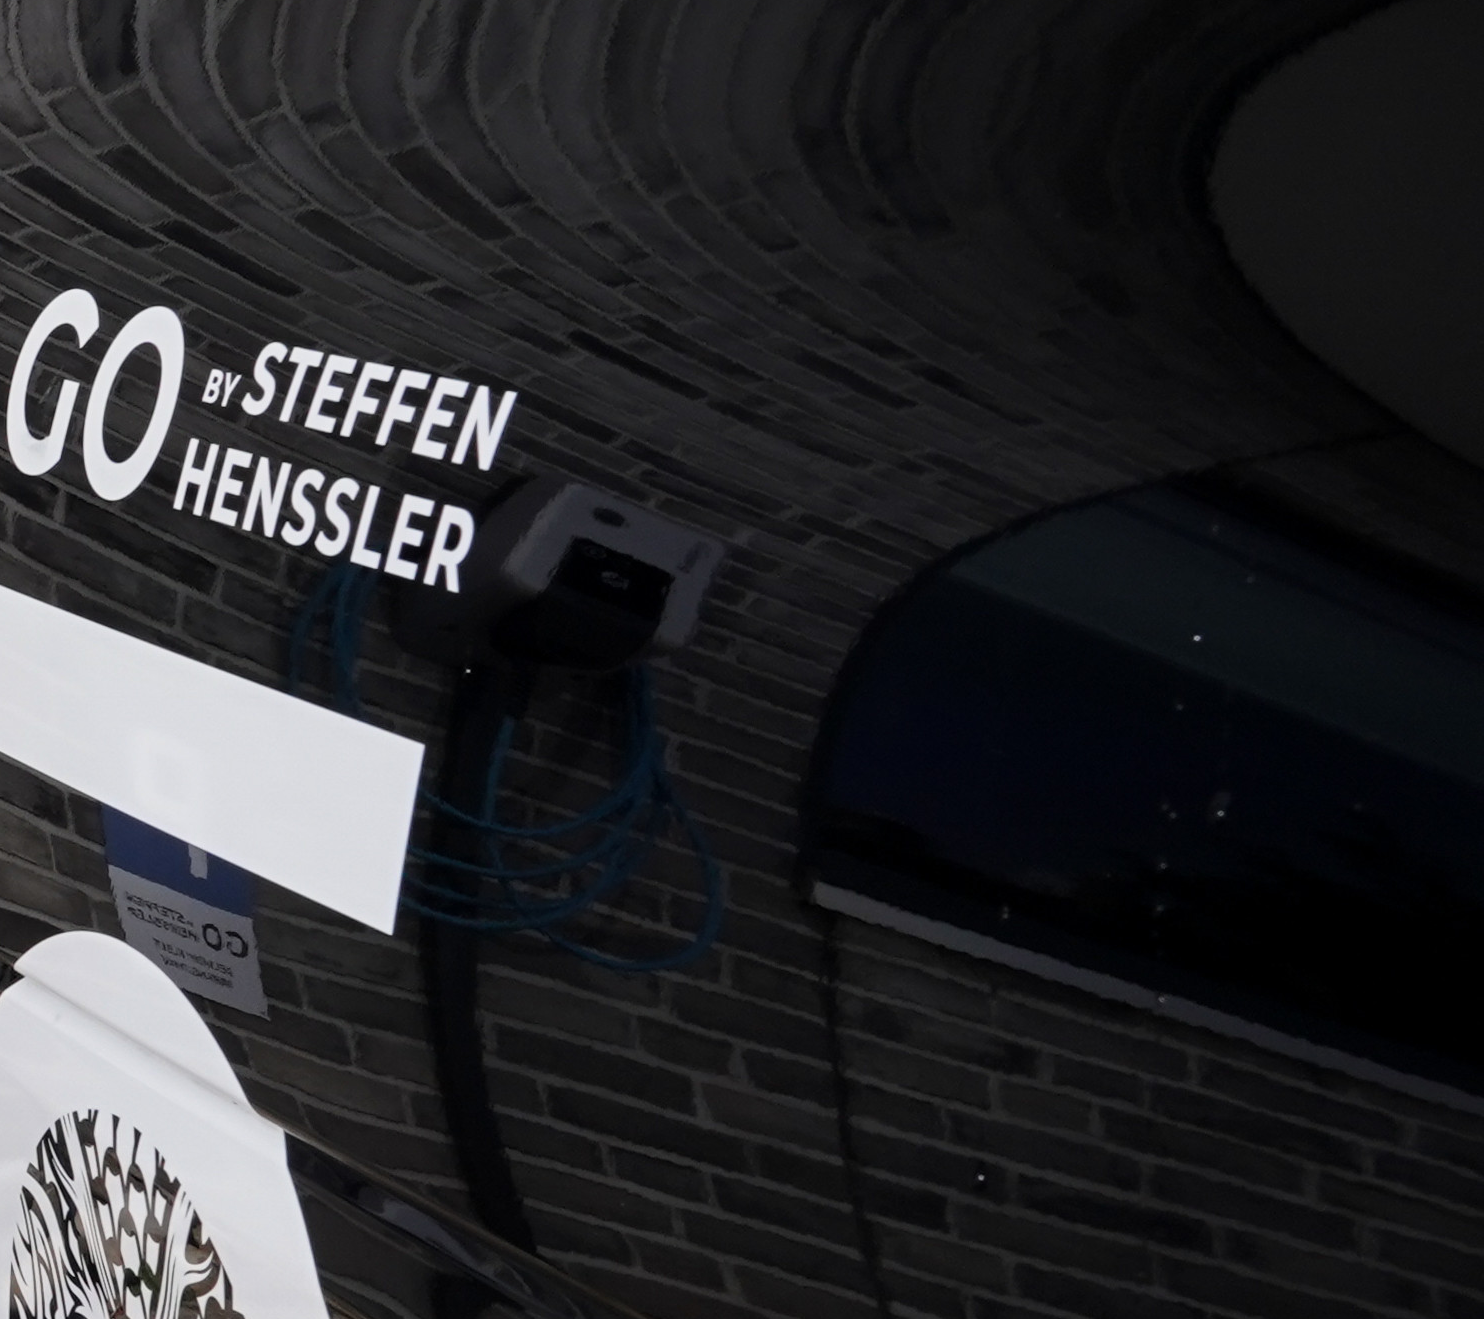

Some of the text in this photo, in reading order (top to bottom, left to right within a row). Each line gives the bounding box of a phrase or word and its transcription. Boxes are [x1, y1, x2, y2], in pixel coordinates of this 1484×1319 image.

[6, 287, 185, 502] GO
[201, 341, 518, 471] BY STEFFEN
[173, 437, 475, 594] HENSSLER
